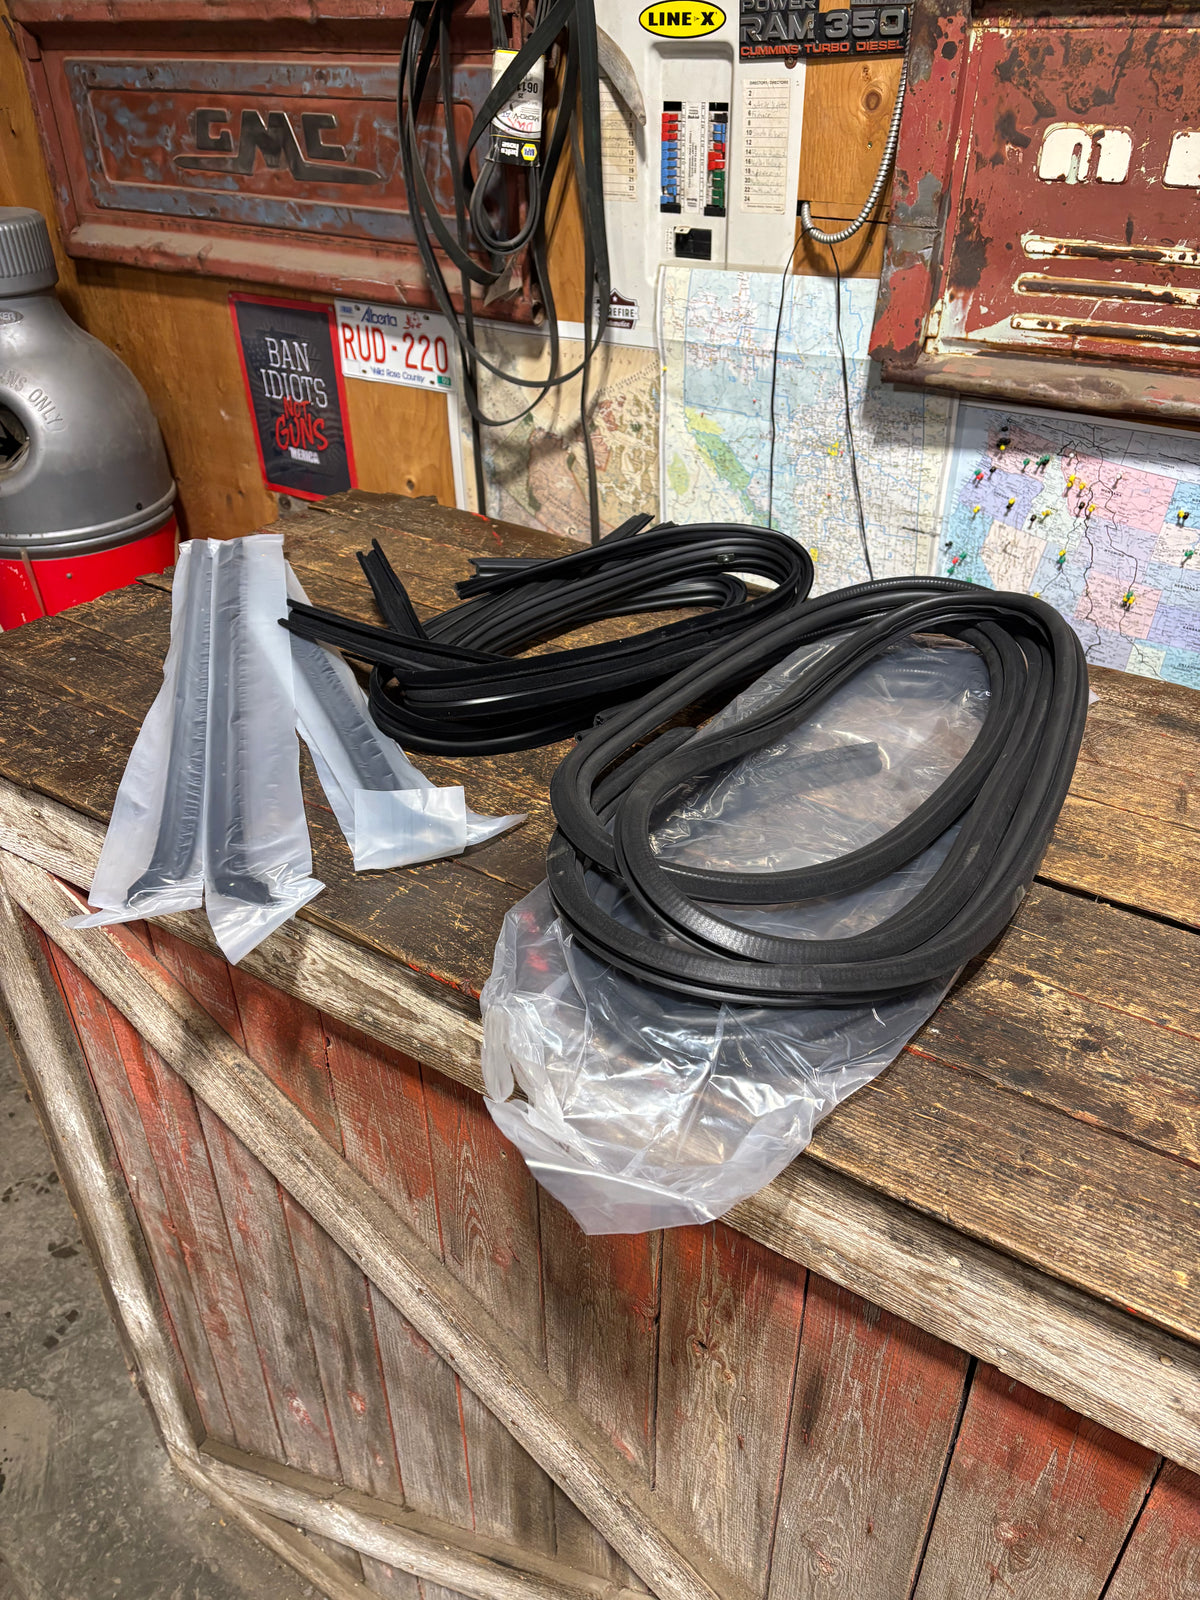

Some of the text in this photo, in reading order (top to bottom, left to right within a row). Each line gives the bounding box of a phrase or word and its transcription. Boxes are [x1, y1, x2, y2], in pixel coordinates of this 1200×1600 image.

[741, 0, 816, 12] POWER
[740, 7, 904, 41] RAM 350
[740, 40, 904, 56] CUMMINS TURBO DIESEL
[517, 82, 538, 93] 0611
[173, 107, 381, 184] GMC
[361, 306, 398, 327] Alberta
[265, 337, 311, 373] BAN
[260, 368, 328, 408] IDIOTS
[370, 366, 425, 384] Wild Rose County
[28, 388, 64, 425] ONLY
[283, 395, 310, 420] NOT
[275, 413, 329, 451] GUNS
